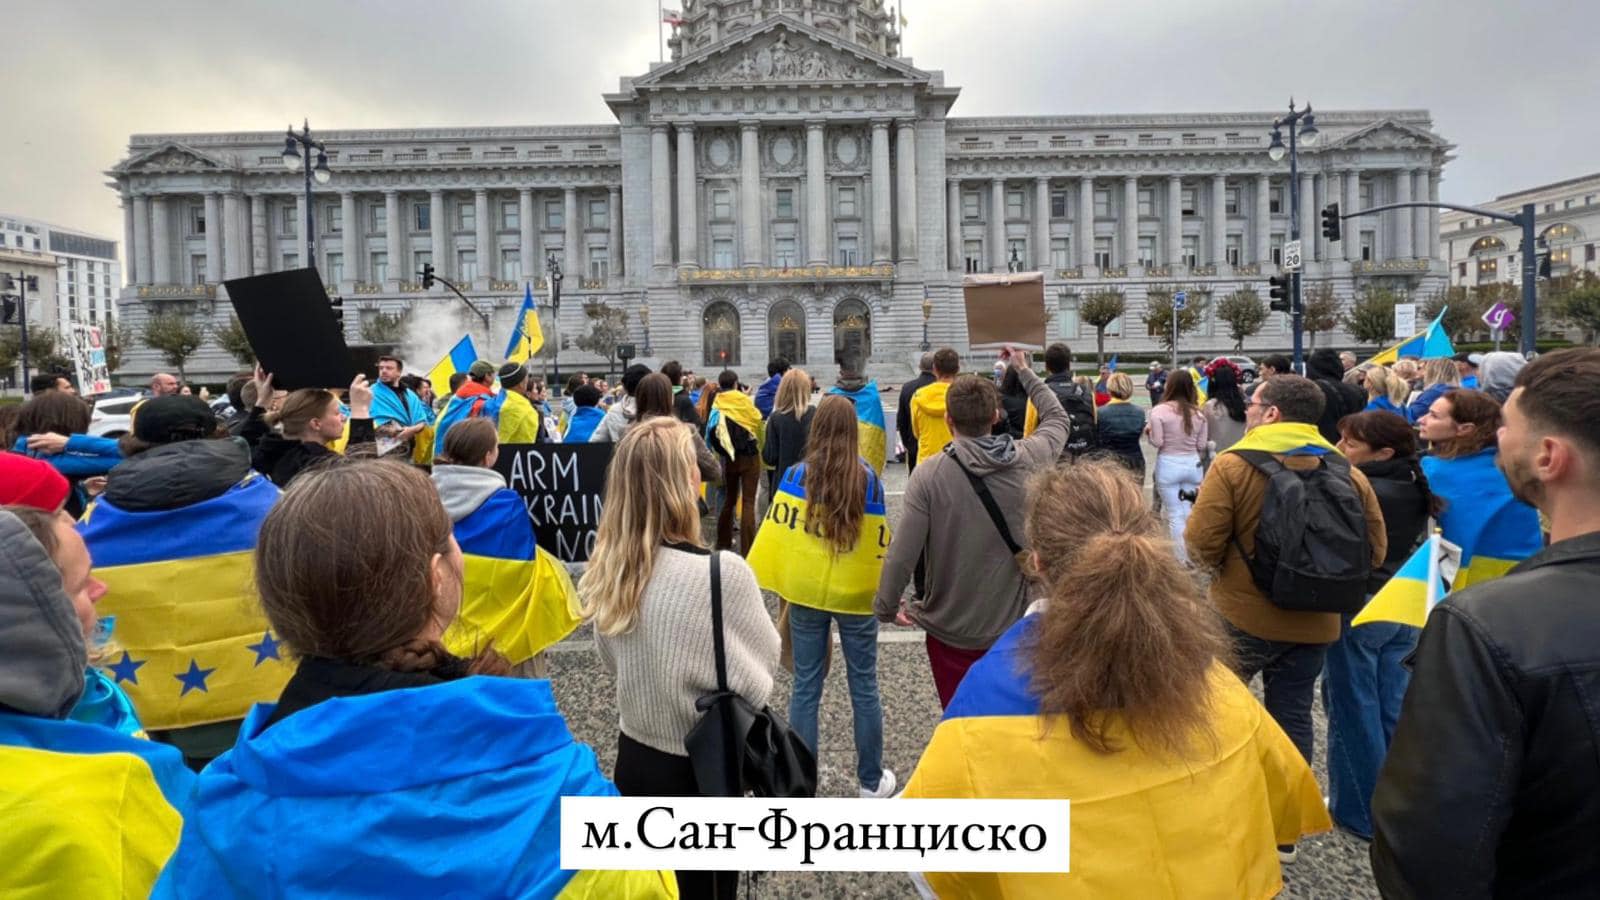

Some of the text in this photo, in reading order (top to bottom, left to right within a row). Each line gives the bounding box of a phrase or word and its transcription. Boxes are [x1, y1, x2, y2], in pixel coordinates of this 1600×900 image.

[1286, 255, 1300, 267] 20
[509, 450, 580, 492] ARM
[523, 493, 604, 527] KRAIN
[556, 528, 598, 562] NO
